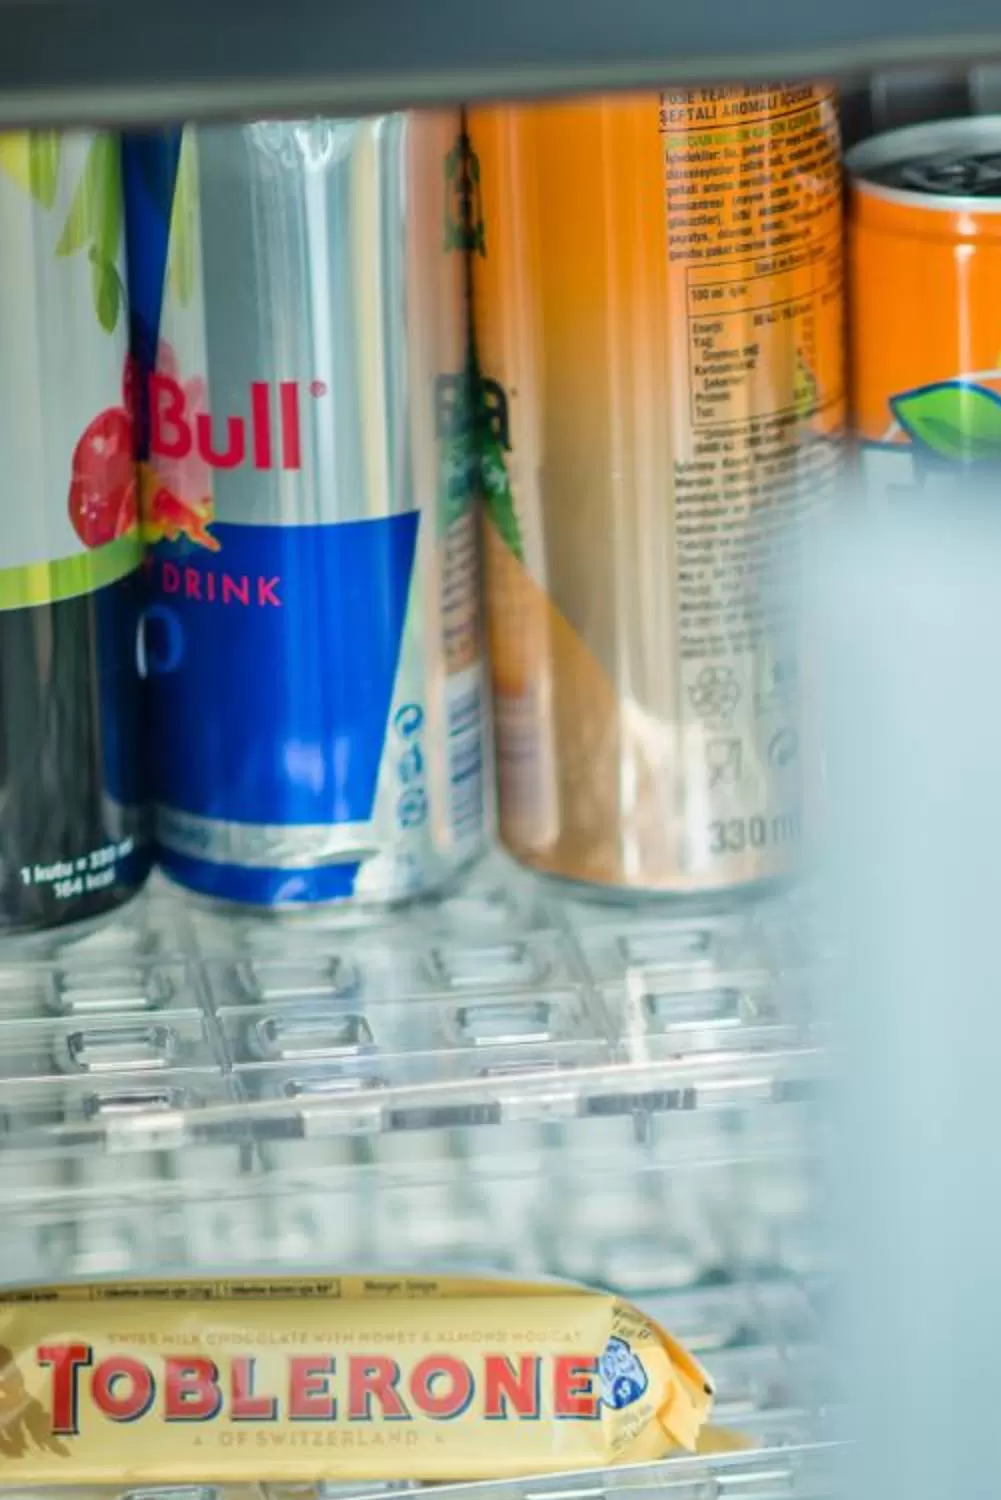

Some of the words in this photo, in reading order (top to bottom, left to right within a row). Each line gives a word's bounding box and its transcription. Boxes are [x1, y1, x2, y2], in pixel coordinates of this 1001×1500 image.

[148, 372, 301, 470] Bull
[162, 563, 284, 607] DRINK
[206, 1331, 308, 1346] CHOCOLATE
[37, 1344, 602, 1436] TOBLERONE
[217, 1430, 249, 1447] OF
[254, 1429, 419, 1447] SWITZERLAND
